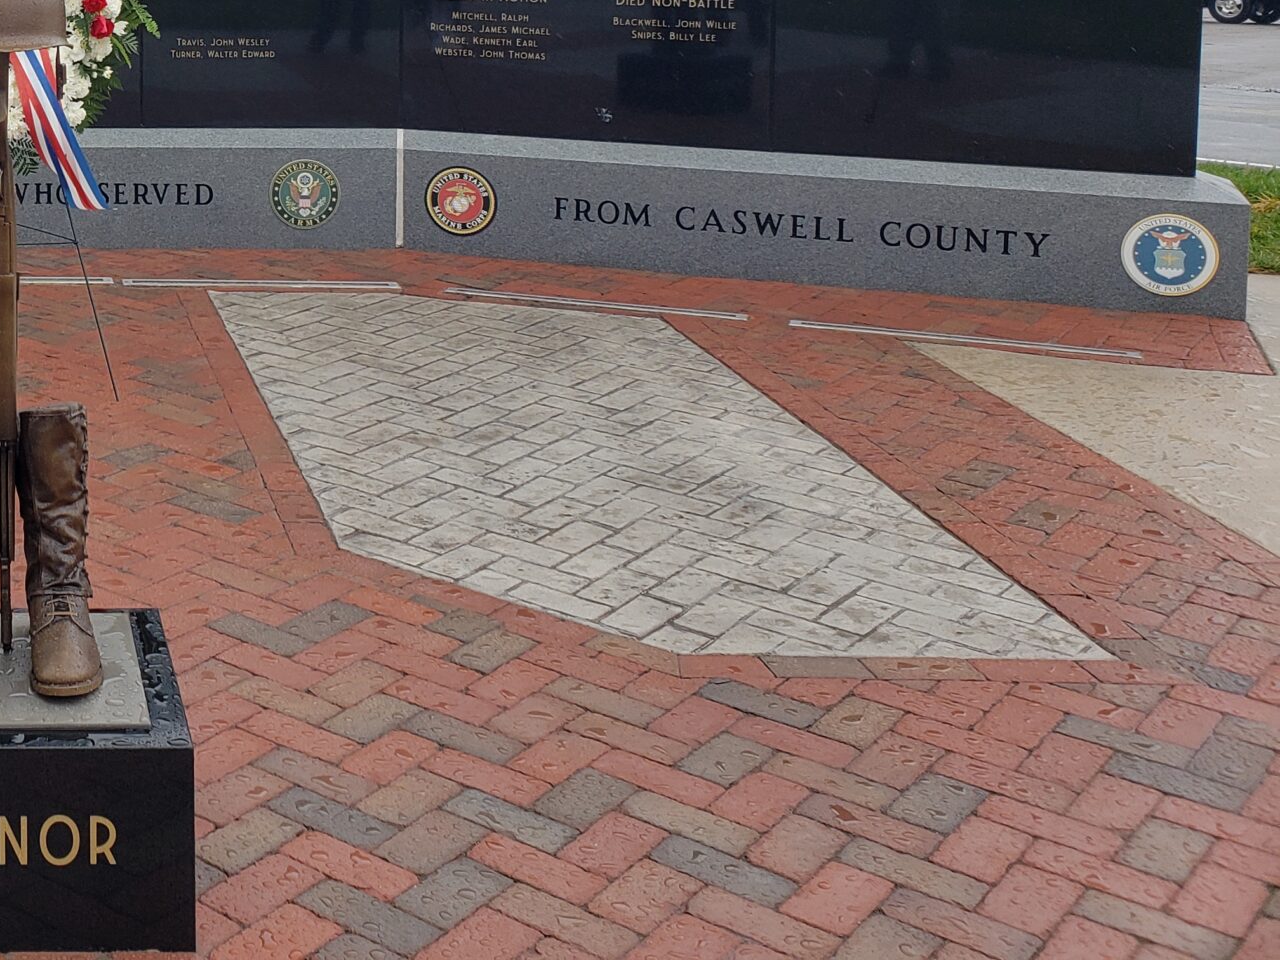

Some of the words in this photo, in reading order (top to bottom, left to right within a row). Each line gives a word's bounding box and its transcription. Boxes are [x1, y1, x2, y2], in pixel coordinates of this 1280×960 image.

[674, 19, 702, 29] JOHN
[705, 20, 737, 30] WILLIE
[210, 38, 234, 47] JOHN
[237, 37, 270, 47] WESLEY
[669, 31, 695, 41] BILLY
[699, 32, 716, 42] LEE
[479, 49, 505, 58] JOHN
[508, 50, 546, 61] THOMAS
[275, 163, 305, 184] UNITED
[307, 163, 336, 186] STATES
[433, 173, 460, 193] UNITED
[463, 173, 489, 197] STATES
[98, 183, 213, 205] SERVED
[289, 218, 320, 227] ARMY
[434, 206, 462, 229] MARINE
[466, 210, 488, 229] CORPS
[554, 197, 651, 227] FROM
[676, 207, 853, 242] CASWELL
[880, 222, 1050, 257] COUNTY
[1138, 218, 1171, 231] UNITED
[1172, 219, 1201, 235] STATES
[1146, 281, 1162, 291] AIR
[1164, 283, 1193, 292] FORCE
